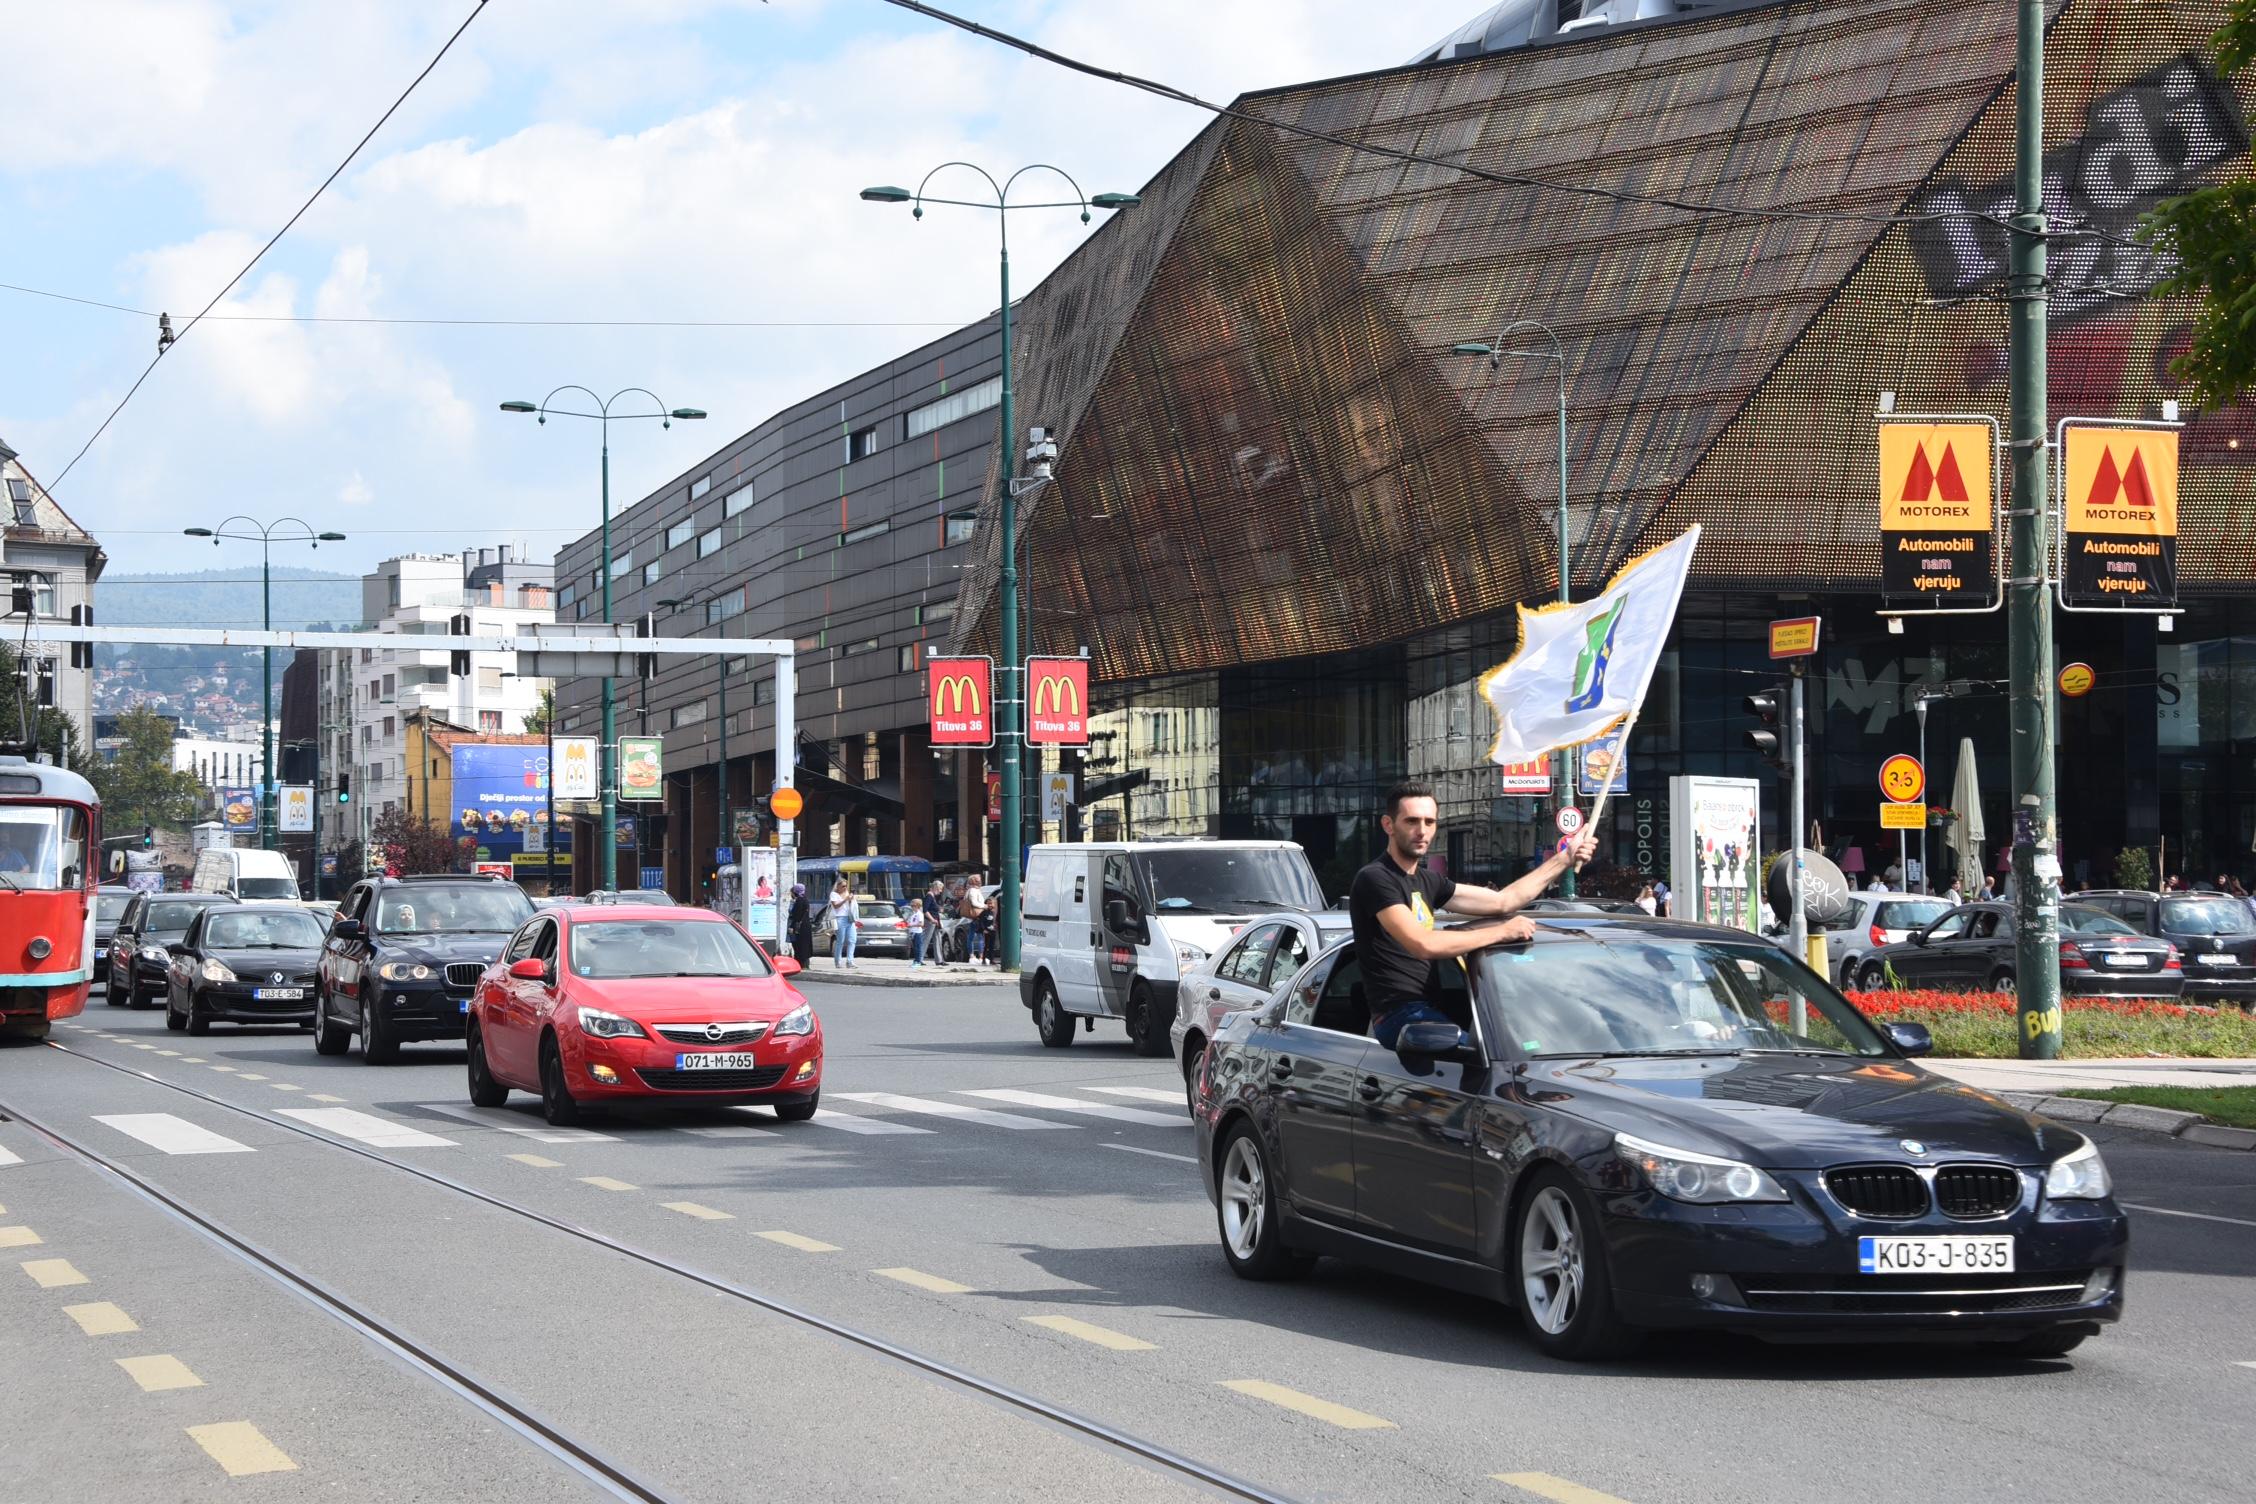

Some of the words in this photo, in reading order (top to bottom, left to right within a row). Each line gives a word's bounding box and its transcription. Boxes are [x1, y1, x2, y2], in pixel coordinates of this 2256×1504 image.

[1899, 506, 1970, 517] MOTOREX
[2085, 509, 2156, 521] MOTOREX
[1898, 537, 1974, 552] Automobili
[2083, 539, 2160, 556] Automobili
[1921, 558, 1952, 570] nam
[2106, 560, 2137, 573] nam
[1913, 574, 1961, 591] vjeruju
[2097, 576, 2146, 593] vjeruju
[936, 721, 967, 732] Titova
[969, 720, 983, 731] 36
[1034, 720, 1065, 732] Titova
[1067, 721, 1081, 731] 36
[505, 794, 534, 802] prostor
[534, 793, 546, 801] od
[1562, 813, 1577, 827] 60
[1878, 1242, 2008, 1268] K03-J-835
